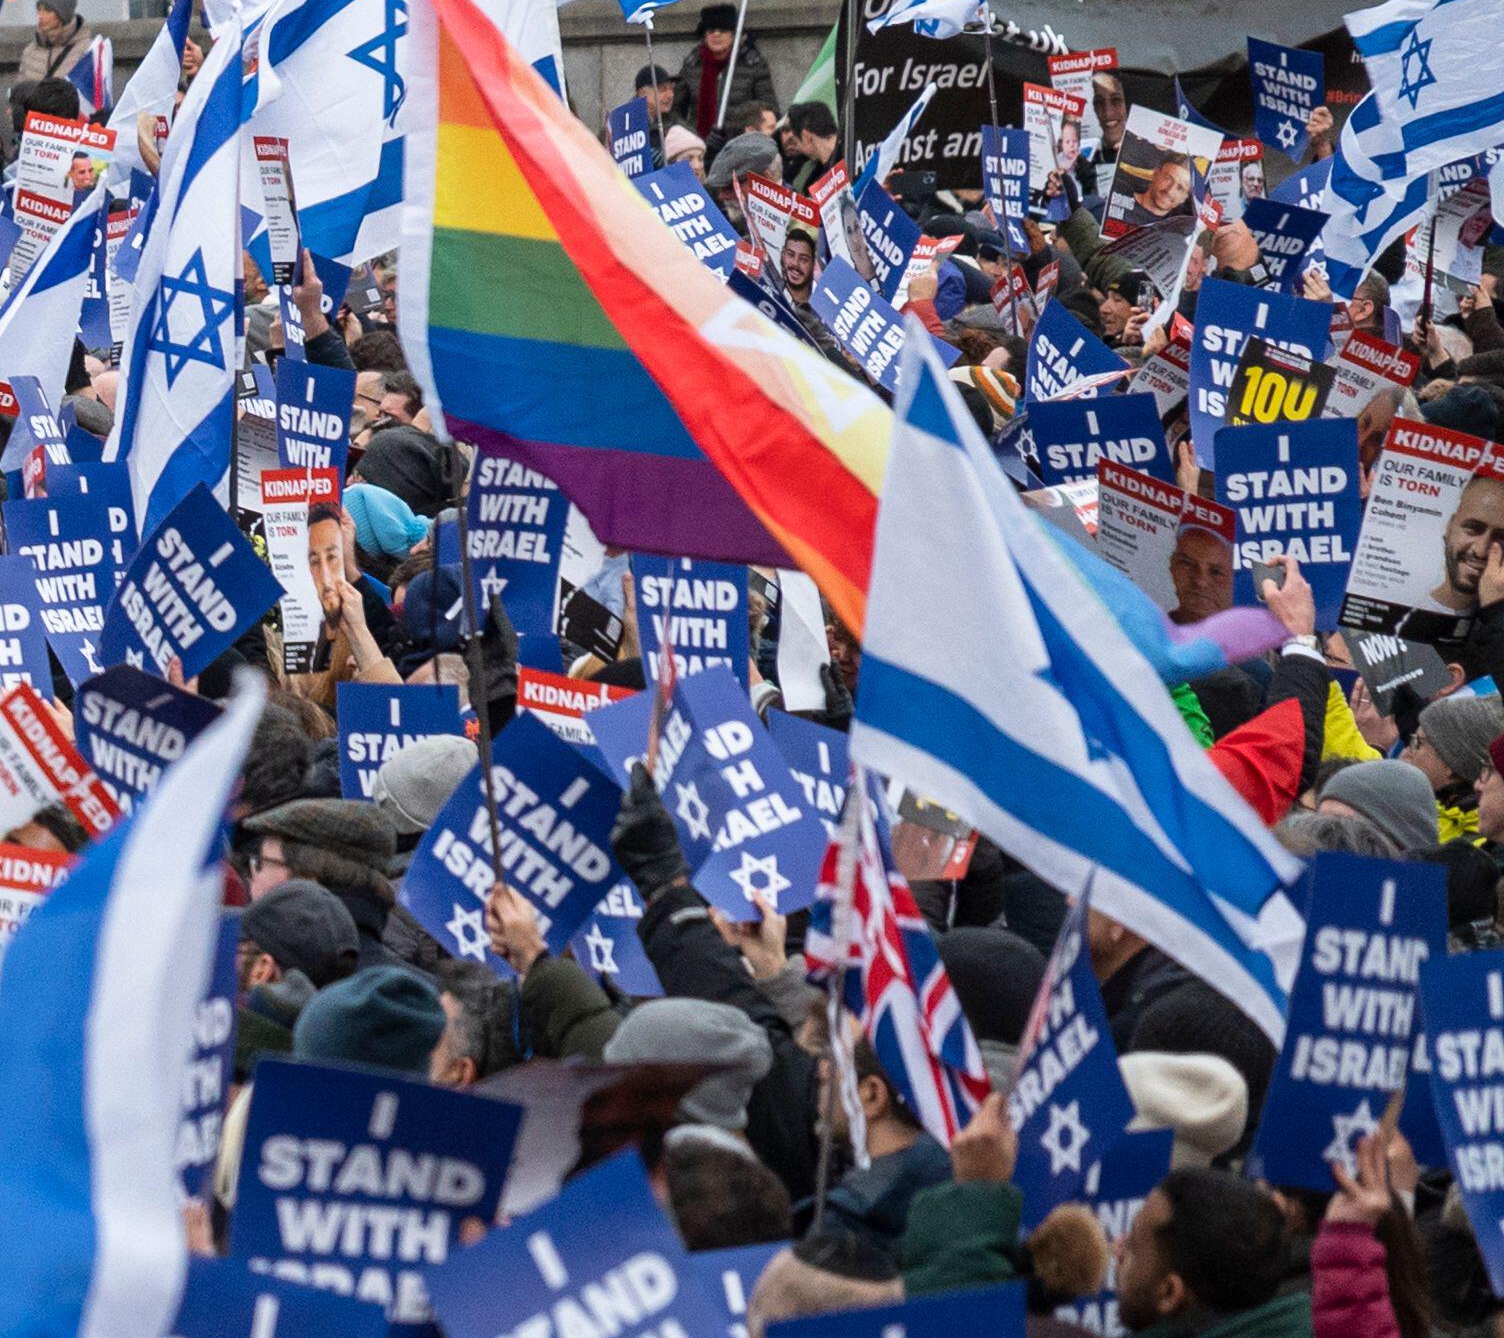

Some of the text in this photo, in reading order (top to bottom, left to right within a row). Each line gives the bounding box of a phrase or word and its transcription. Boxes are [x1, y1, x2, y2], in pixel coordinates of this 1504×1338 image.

[854, 57, 988, 98] For Israel
[1254, 63, 1317, 91] STAND
[29, 115, 109, 146] KIDNAPPED
[280, 406, 343, 440] STAND
[264, 477, 332, 500] KIDNAPPED
[1225, 468, 1347, 502] STAND
[1383, 458, 1467, 489] OUR FAMILY
[1397, 478, 1442, 498] TORN
[1099, 491, 1128, 513] OUR
[1103, 466, 1225, 528] KIDNAPPED
[276, 524, 298, 537] TORN
[1117, 513, 1158, 536] TORN
[1236, 502, 1337, 535] WITH
[35, 577, 95, 603] WITH
[1321, 983, 1415, 1038] WITH
[367, 1091, 393, 1141] I
[257, 1132, 489, 1208] STAND
[275, 1196, 451, 1263] WITH
[524, 1231, 570, 1288] I
